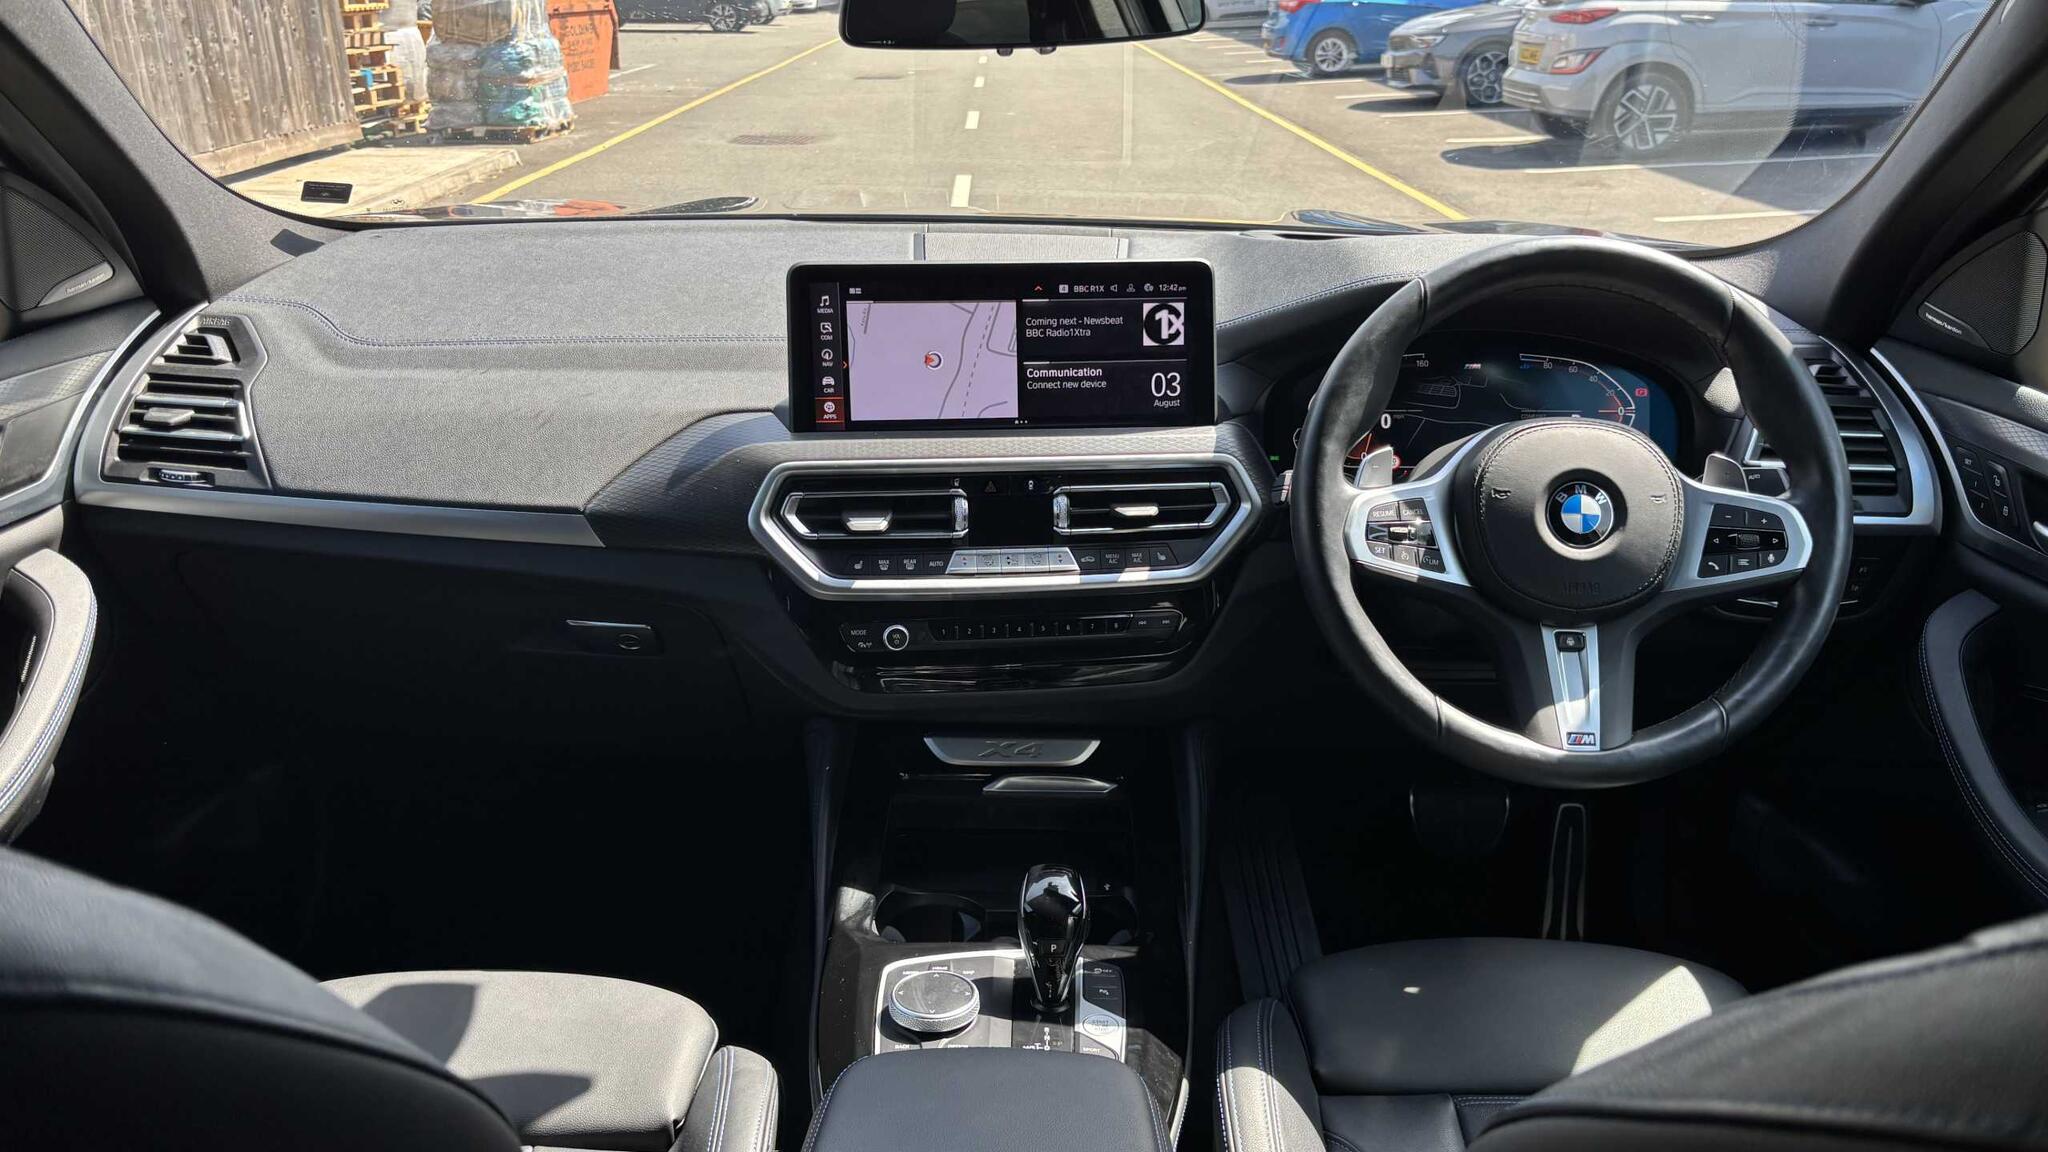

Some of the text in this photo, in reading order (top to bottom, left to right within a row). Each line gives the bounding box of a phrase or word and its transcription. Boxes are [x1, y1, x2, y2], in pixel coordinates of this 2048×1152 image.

[1073, 285, 1105, 293] BBC R1X
[1158, 284, 1178, 292] 12:42
[1025, 317, 1057, 327] Coming
[1059, 317, 1077, 326] next
[1083, 316, 1124, 326] Newsbeat
[1025, 327, 1091, 338] BBC Radio1Xtra
[1026, 367, 1103, 378] Communication
[1026, 379, 1107, 390] Connect new device
[1151, 372, 1181, 397] 03
[1153, 399, 1181, 409] August
[1380, 413, 1392, 429] 0
[1555, 484, 1608, 505] BMW
[1374, 546, 1386, 554] SET
[978, 740, 1044, 759] X4
[1050, 944, 1057, 953] P
